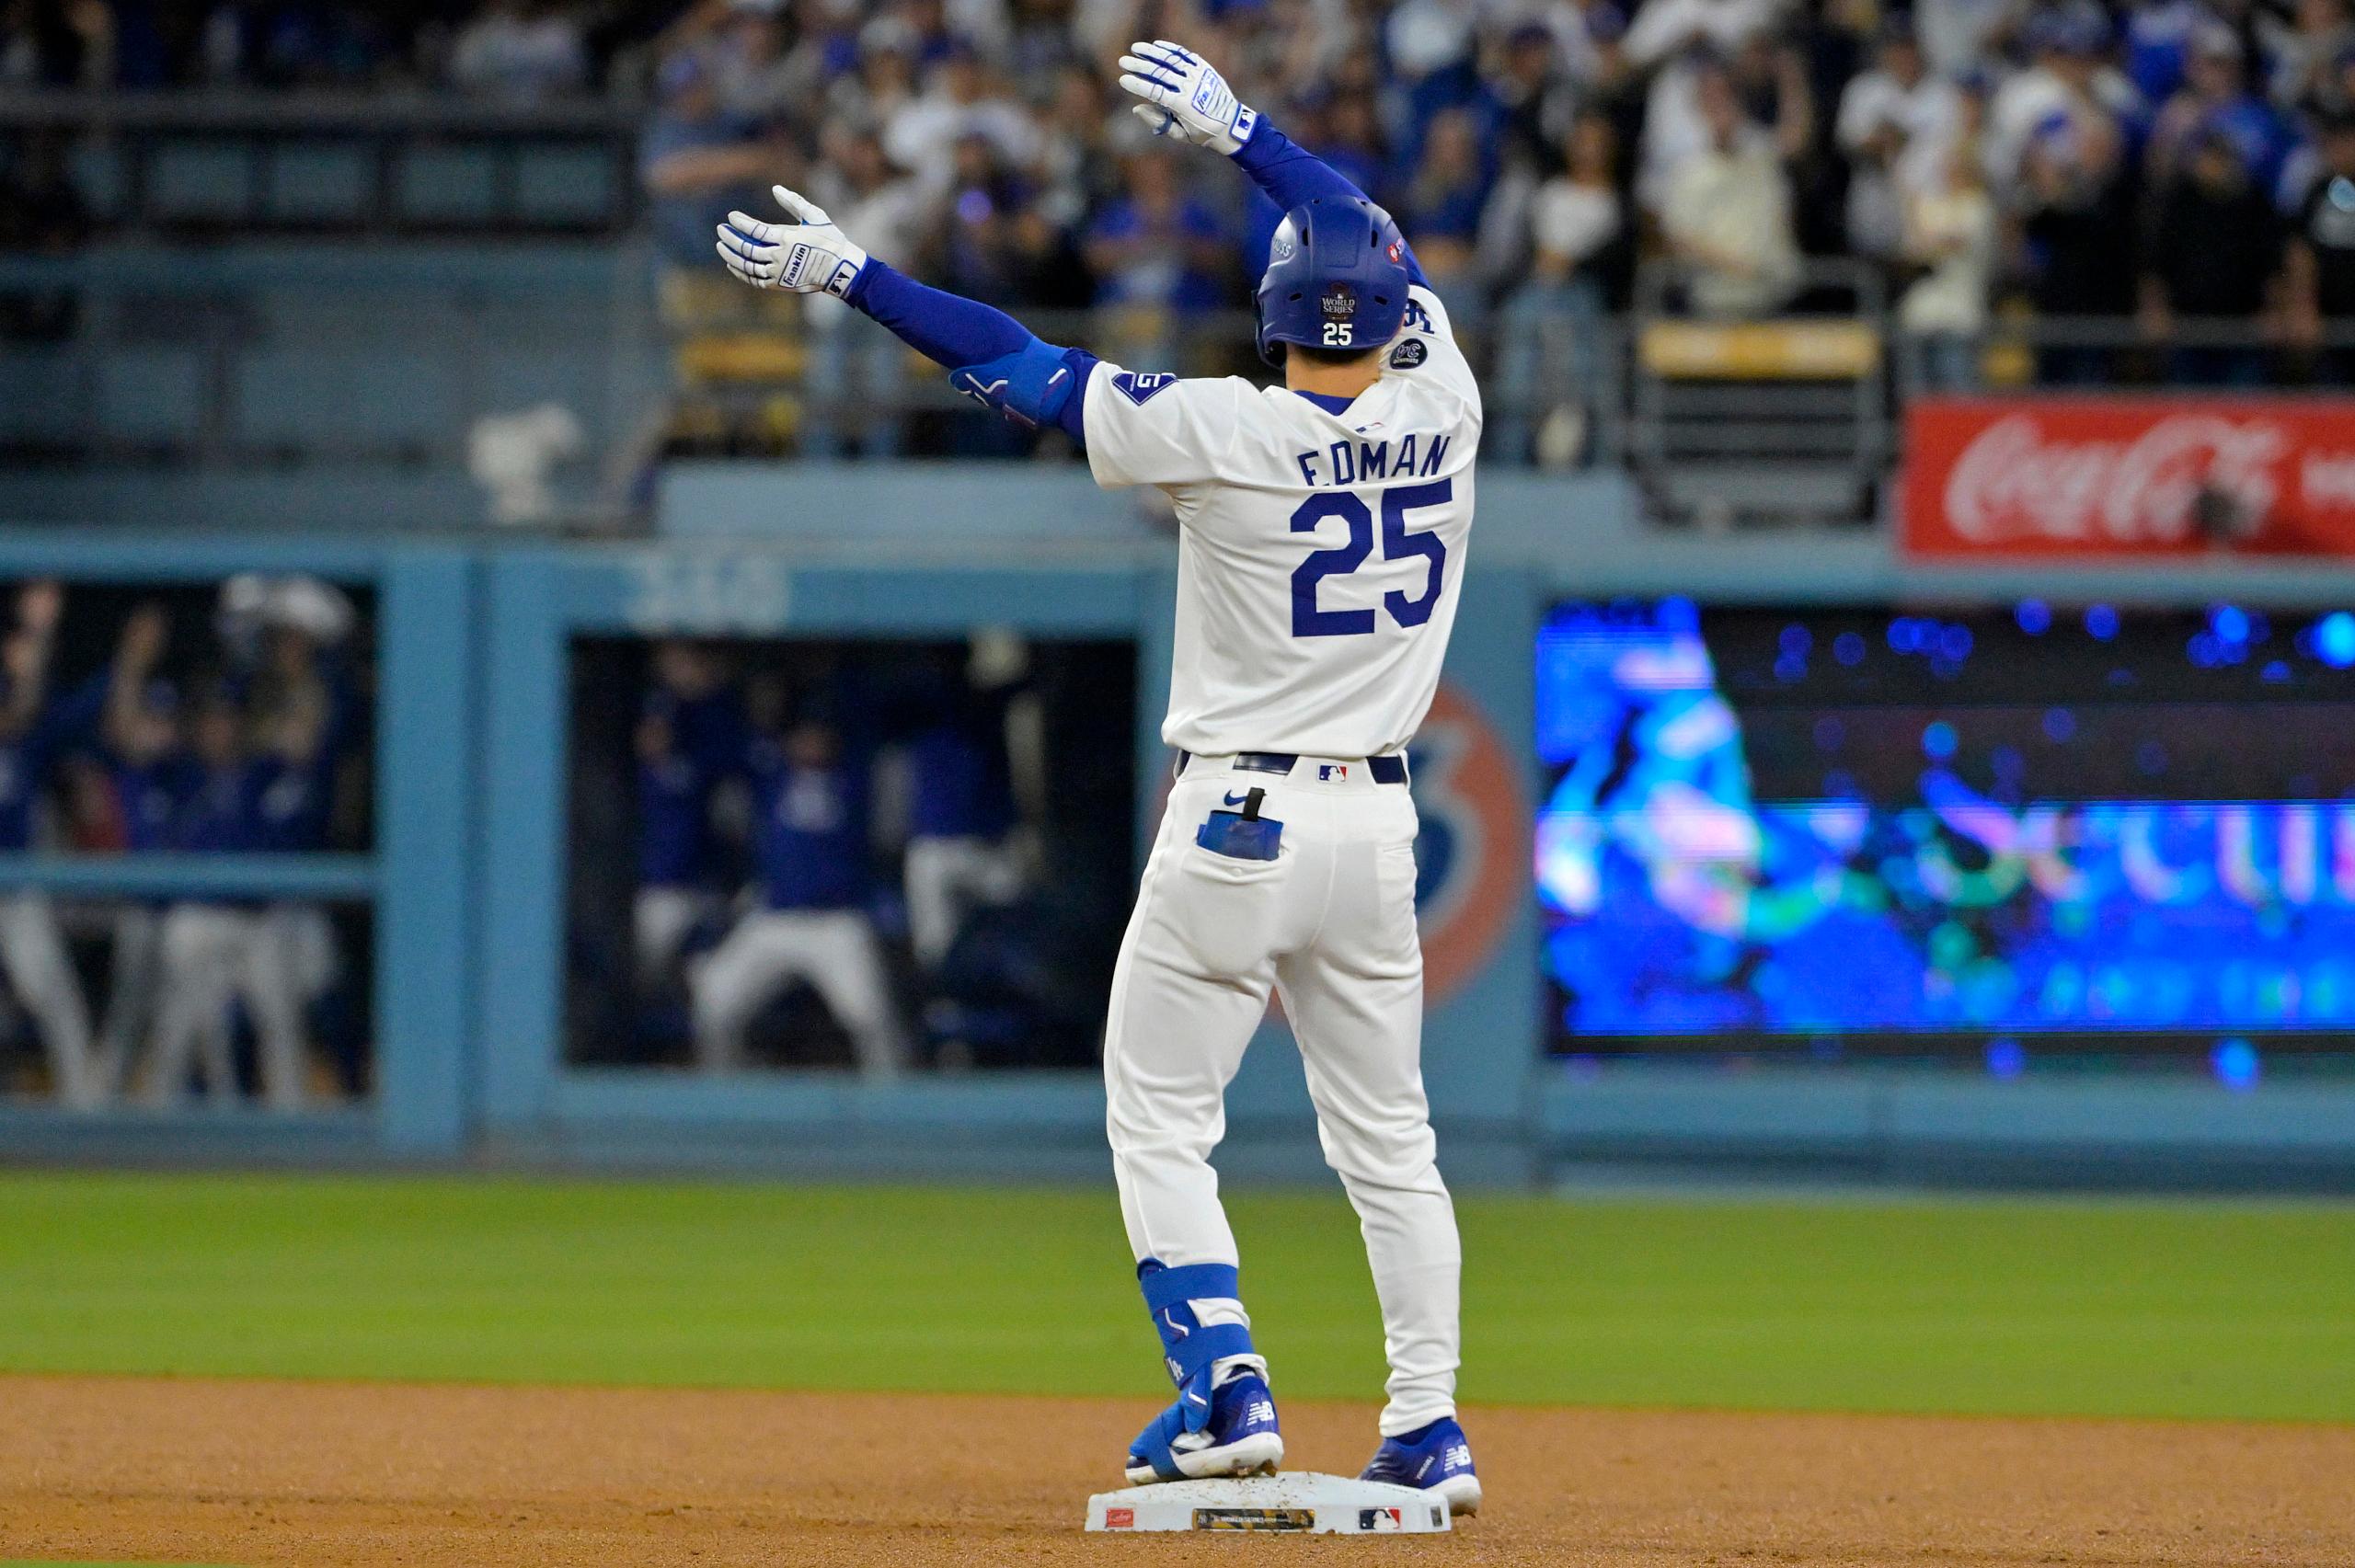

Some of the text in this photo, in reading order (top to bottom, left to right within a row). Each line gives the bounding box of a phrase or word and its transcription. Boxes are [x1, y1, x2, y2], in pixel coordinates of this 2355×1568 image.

[1322, 297, 1355, 306] WORLD
[1323, 305, 1353, 314] SERIES
[1323, 322, 1352, 346] 25
[1297, 433, 1451, 486] EDMAN
[1290, 477, 1453, 637] 25
